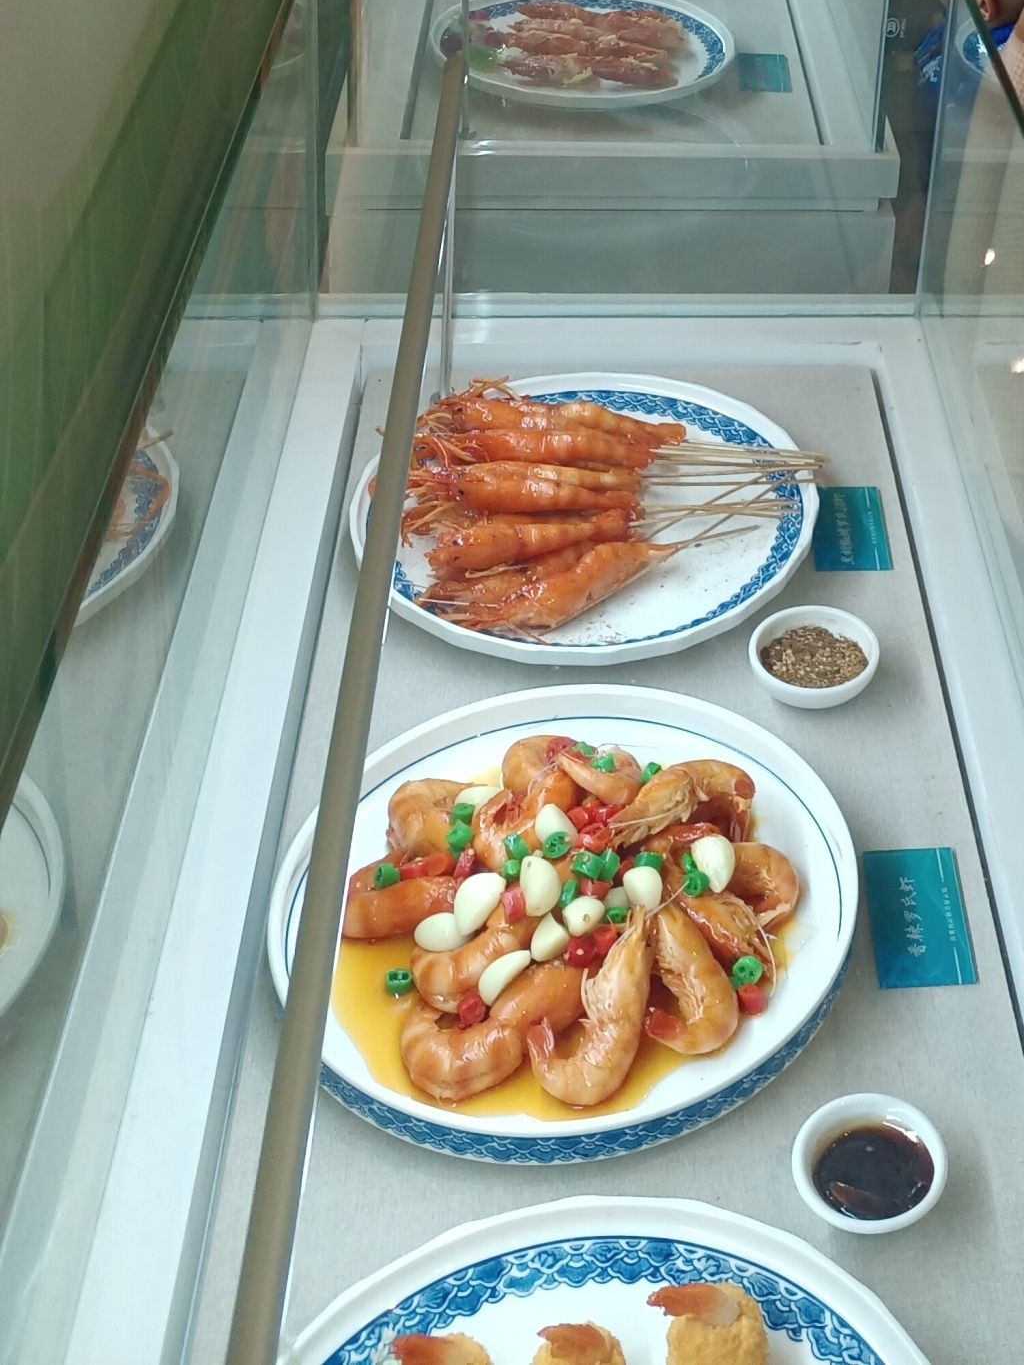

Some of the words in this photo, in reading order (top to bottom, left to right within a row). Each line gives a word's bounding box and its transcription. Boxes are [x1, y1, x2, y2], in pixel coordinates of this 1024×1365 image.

[898, 875, 928, 958] 香辣罗氏虾
